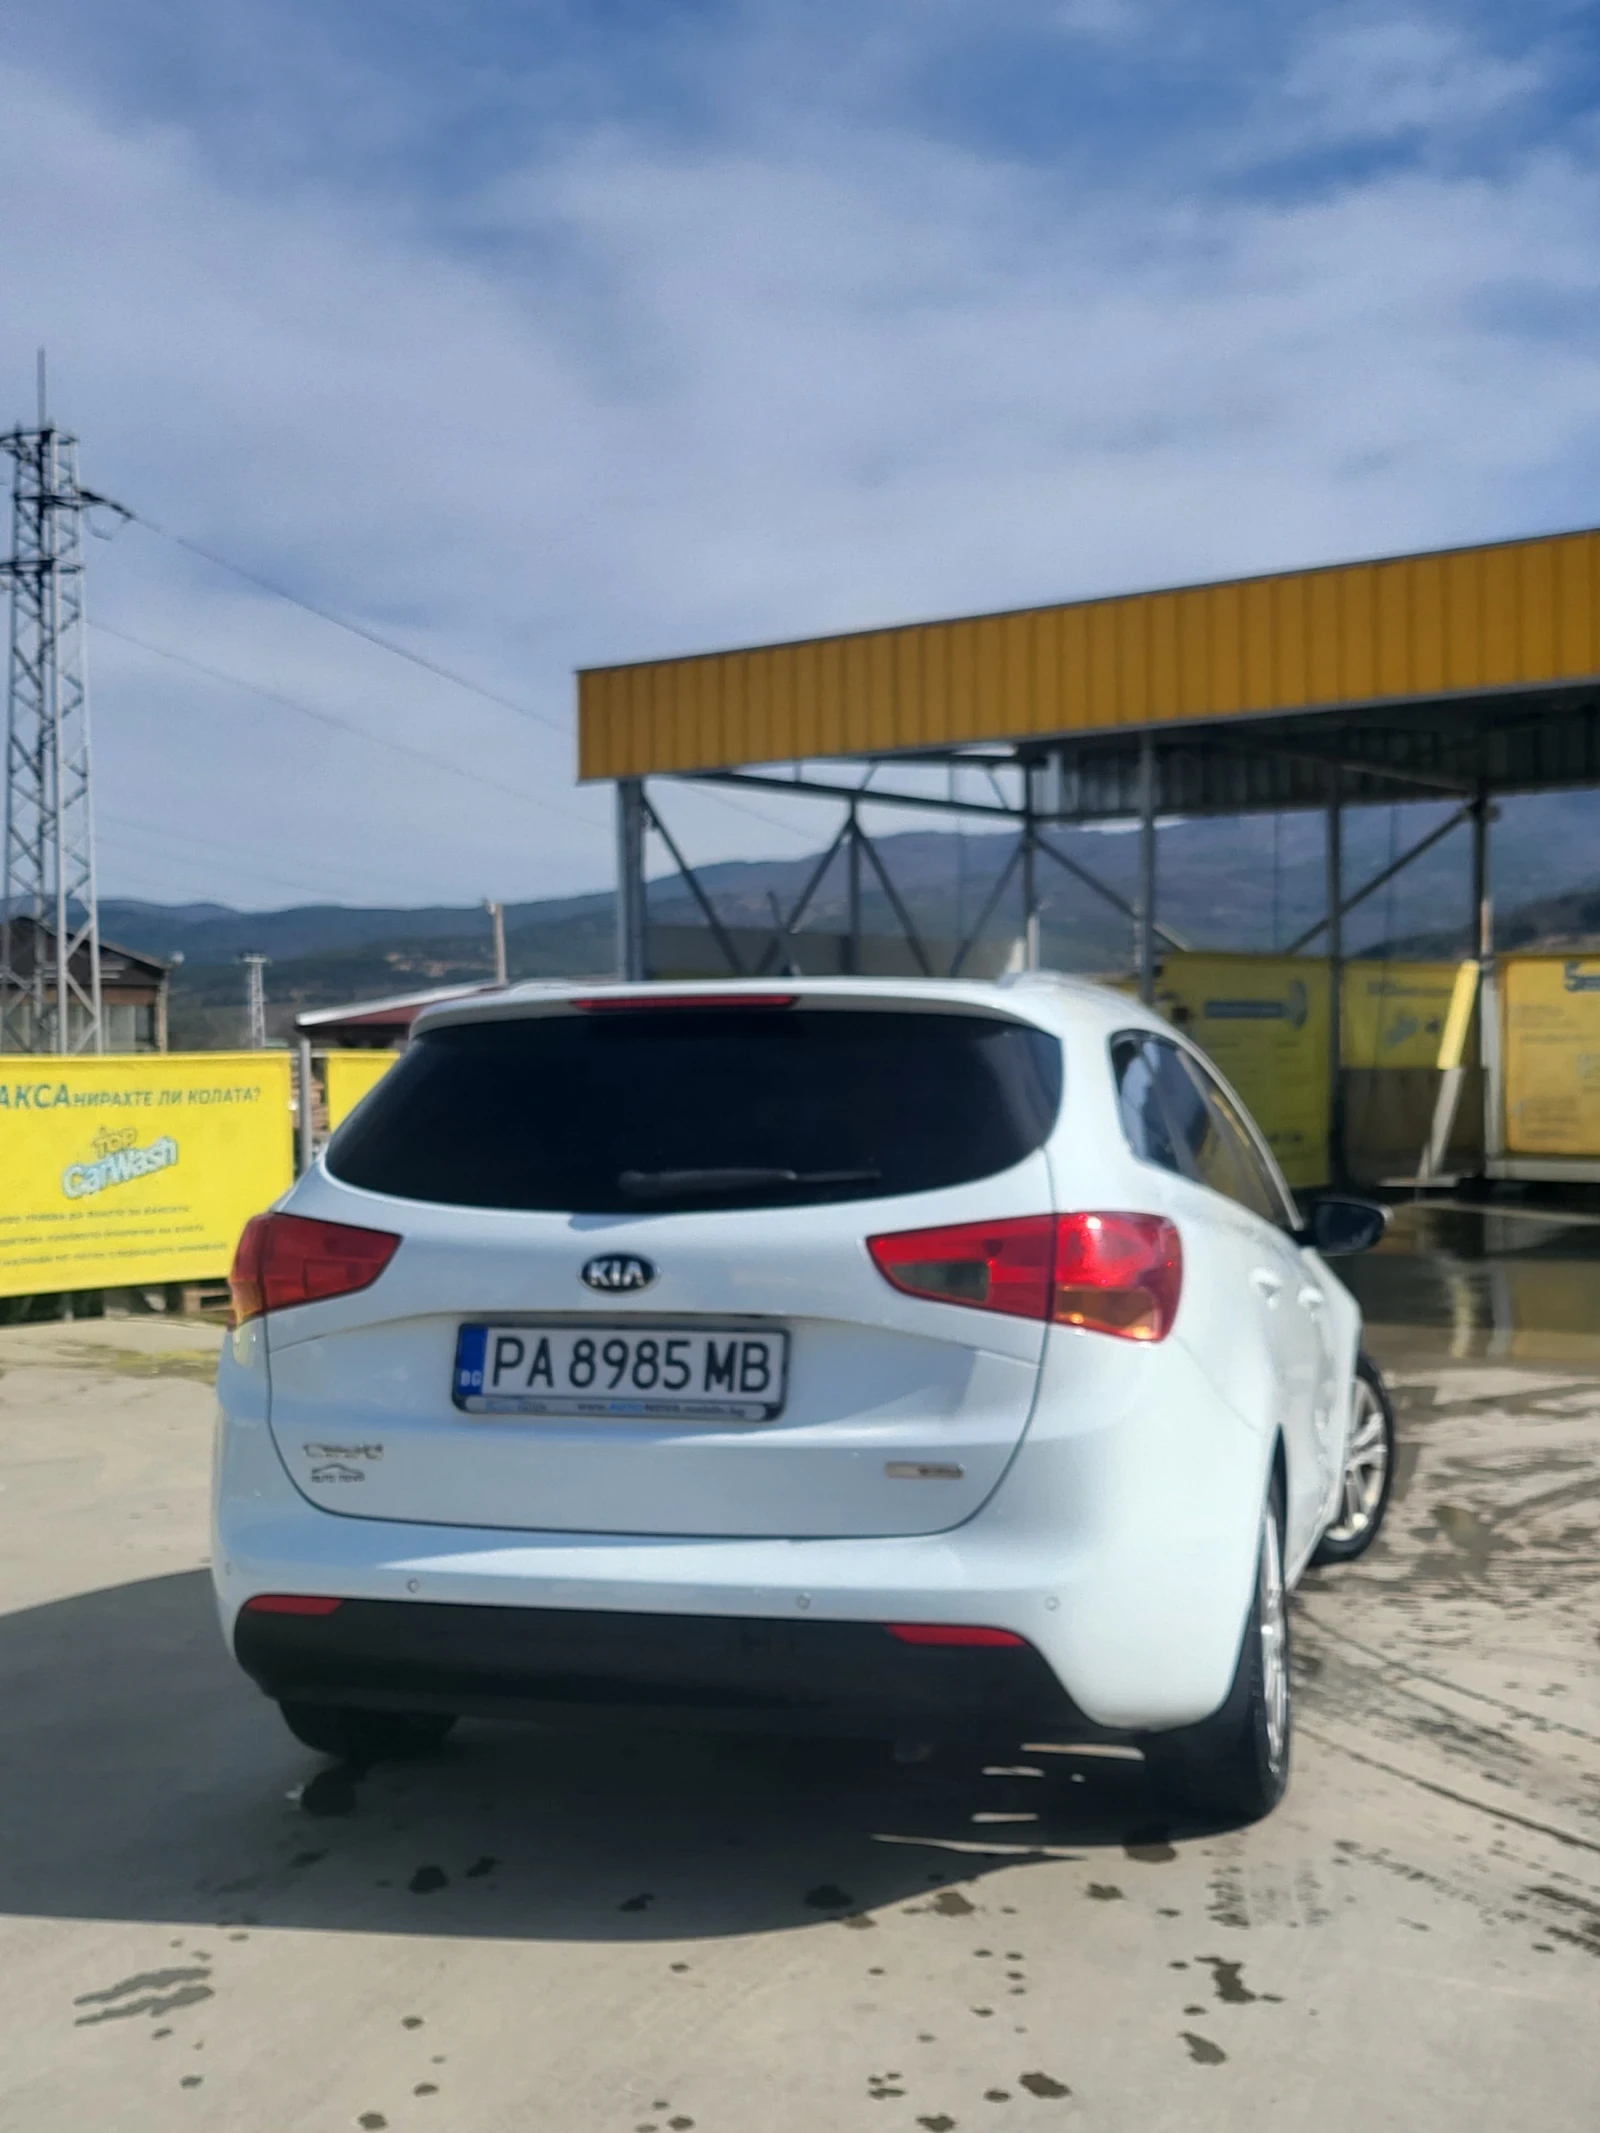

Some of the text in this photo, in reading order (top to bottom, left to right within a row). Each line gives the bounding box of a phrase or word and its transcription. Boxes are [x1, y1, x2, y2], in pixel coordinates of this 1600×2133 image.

[157, 1090, 183, 1106] ЛИ
[187, 1086, 262, 1105] КОЛАТА?
[589, 1260, 646, 1287] KIA
[492, 1336, 771, 1393] PA 8985 MB
[460, 1370, 483, 1387] BG
